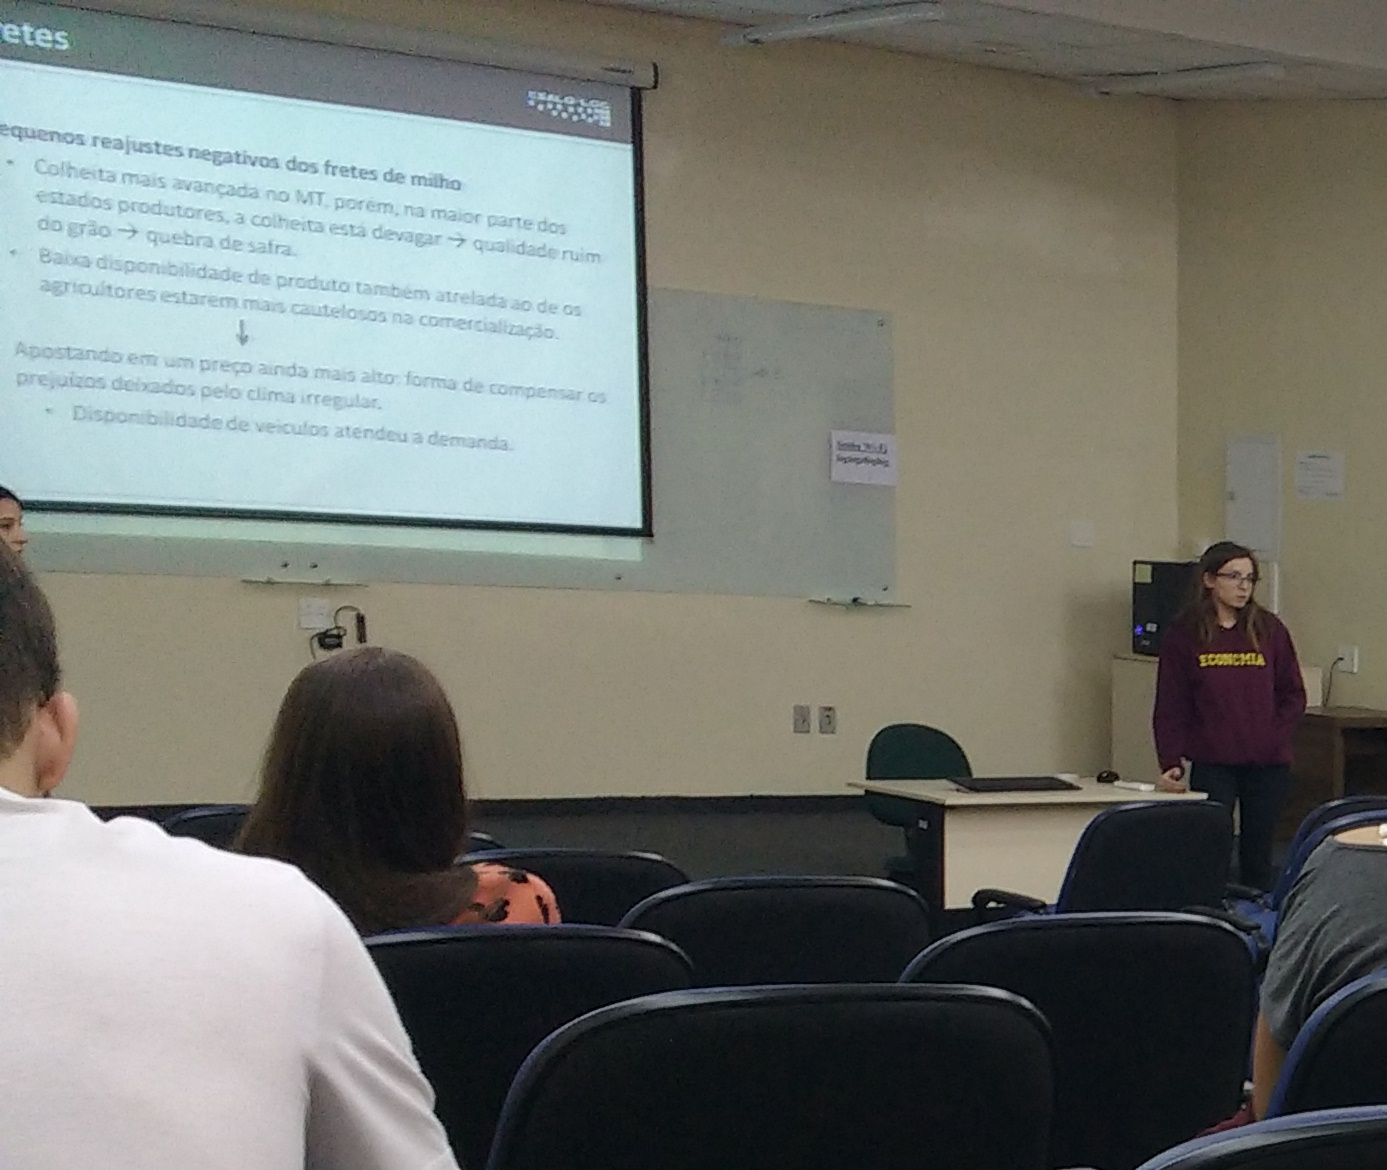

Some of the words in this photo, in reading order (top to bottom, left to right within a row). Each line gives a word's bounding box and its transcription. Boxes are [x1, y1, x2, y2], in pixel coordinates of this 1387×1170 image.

[0, 21, 70, 50] etes
[92, 134, 184, 159] reajustes
[188, 146, 279, 170] negativos
[286, 155, 319, 175] dos
[324, 159, 378, 182] fretes
[383, 167, 406, 185] de
[411, 172, 463, 191] milho
[34, 159, 117, 182] Colheita
[122, 170, 167, 190] mais
[172, 176, 260, 200] avançada
[266, 188, 290, 203] no
[334, 194, 399, 218] porém,
[404, 203, 425, 219] na
[431, 205, 482, 225] maior
[487, 213, 534, 231] parte
[537, 216, 567, 236] dos
[36, 190, 113, 212] estados
[118, 199, 230, 224] produtores,
[235, 212, 245, 224] a
[251, 211, 324, 233] colheita
[329, 219, 366, 238] está
[371, 224, 443, 248] devagar
[473, 236, 559, 260] qualidade
[561, 246, 602, 264] ruim
[37, 216, 63, 232] do
[67, 218, 112, 239] grão
[146, 228, 213, 249] quebra
[219, 234, 244, 251] de
[39, 248, 92, 269] Baixa
[96, 254, 243, 283] disponibilidade
[249, 268, 271, 286] de
[276, 275, 351, 294] produto
[356, 280, 430, 301] também
[435, 289, 507, 309] atrelada
[510, 298, 533, 313] ao
[537, 299, 559, 316] de
[562, 302, 582, 317] os
[39, 278, 157, 301] agricultores
[160, 288, 239, 310] estarem
[243, 297, 286, 314] mais
[290, 302, 387, 323] cautelosos
[392, 311, 415, 325] na
[419, 312, 560, 341] comercialização.
[15, 340, 123, 364] Apostando
[126, 352, 158, 367] em
[164, 355, 194, 369] um
[199, 357, 252, 378] preço
[258, 361, 309, 379] ainda
[314, 366, 356, 383] mais
[405, 370, 457, 391] forma
[463, 377, 485, 394] de
[489, 381, 584, 401] compensar
[587, 389, 607, 404] os
[111, 376, 196, 396] deixados
[201, 384, 242, 402] pelo
[247, 386, 296, 404] clima
[300, 391, 383, 410] irregular.
[72, 404, 223, 431] Disponibilidade
[226, 416, 249, 432] de
[334, 424, 408, 443] atendeu
[413, 431, 423, 444] a
[1198, 652, 1266, 667] ECONOMIA
